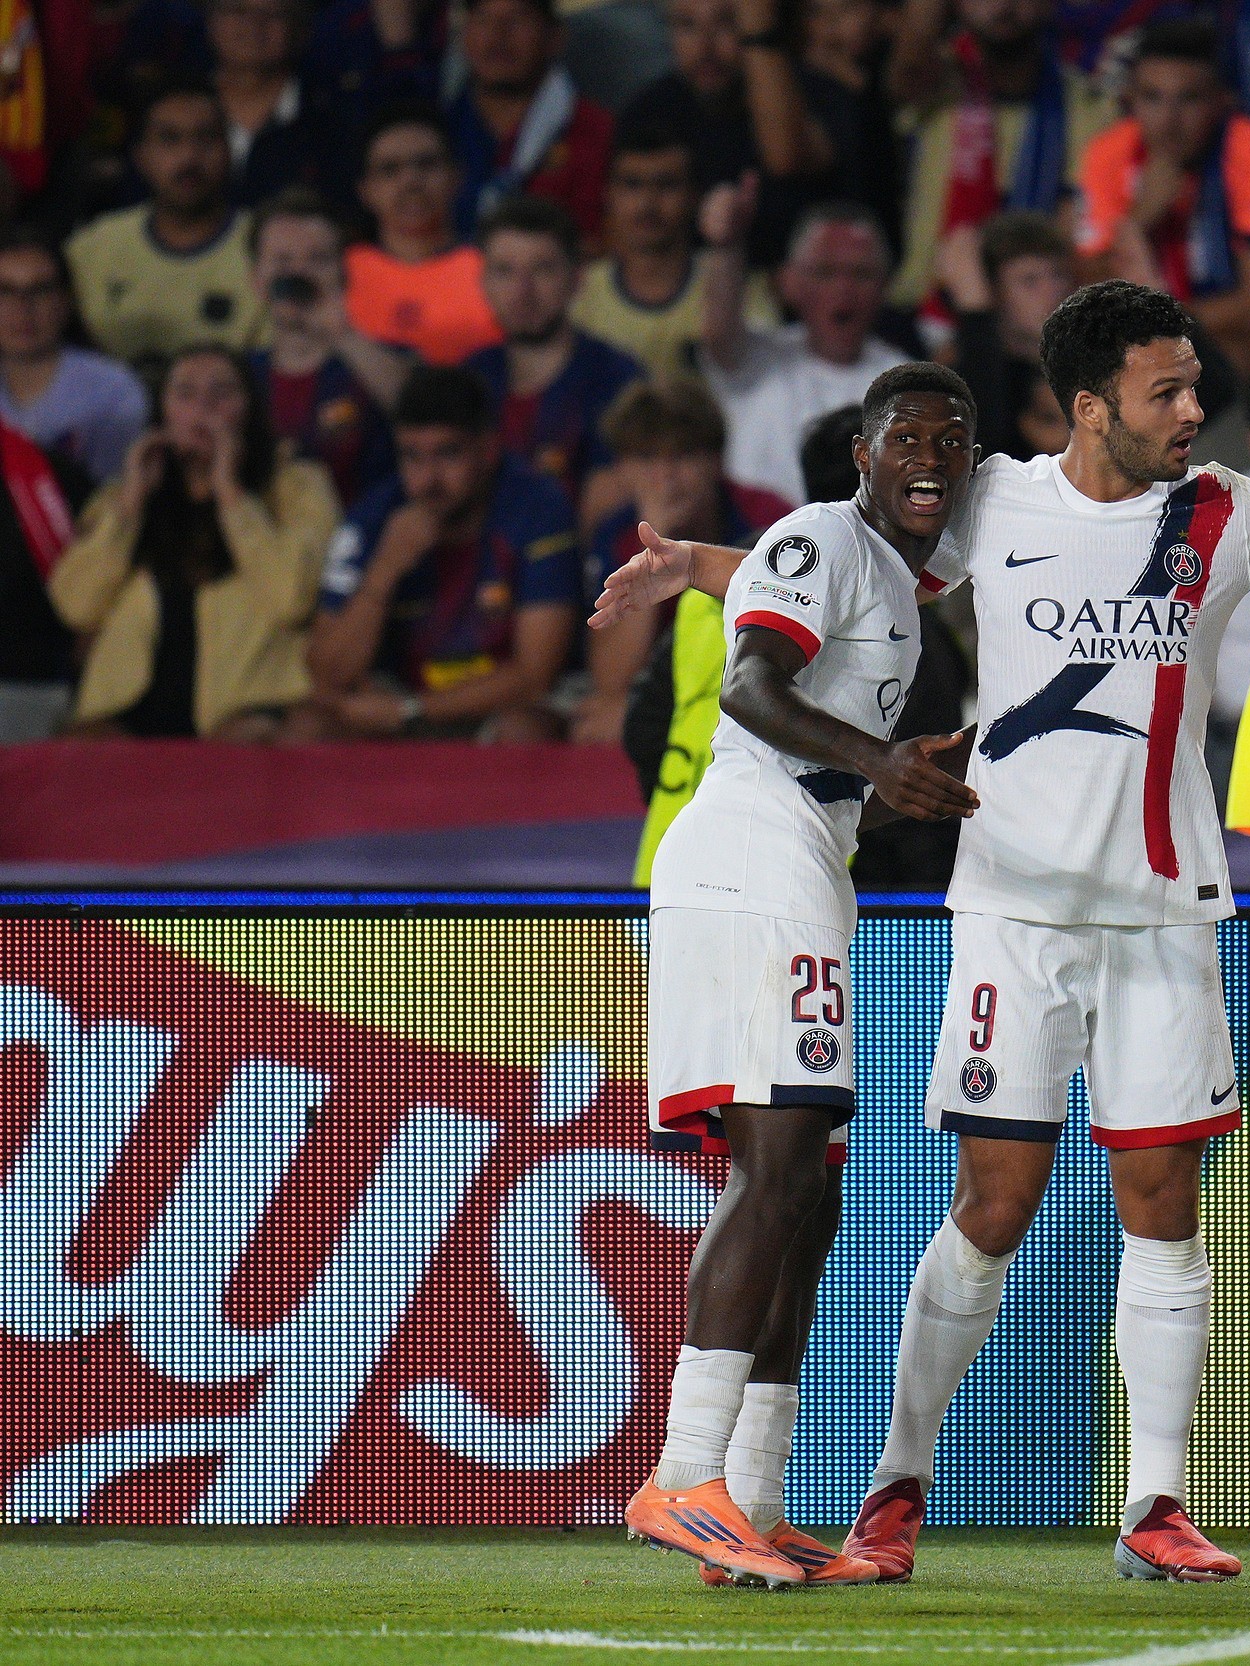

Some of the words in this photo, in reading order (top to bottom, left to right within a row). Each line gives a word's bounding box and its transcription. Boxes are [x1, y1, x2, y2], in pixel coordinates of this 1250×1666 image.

[1170, 546, 1195, 557] PARIS
[1025, 597, 1189, 641] QATAR
[1068, 637, 1188, 663] AIRWAYS
[791, 954, 845, 1026] 25
[969, 982, 998, 1052] 9
[804, 1031, 833, 1044] PARIS
[964, 1060, 989, 1072] PARIS
